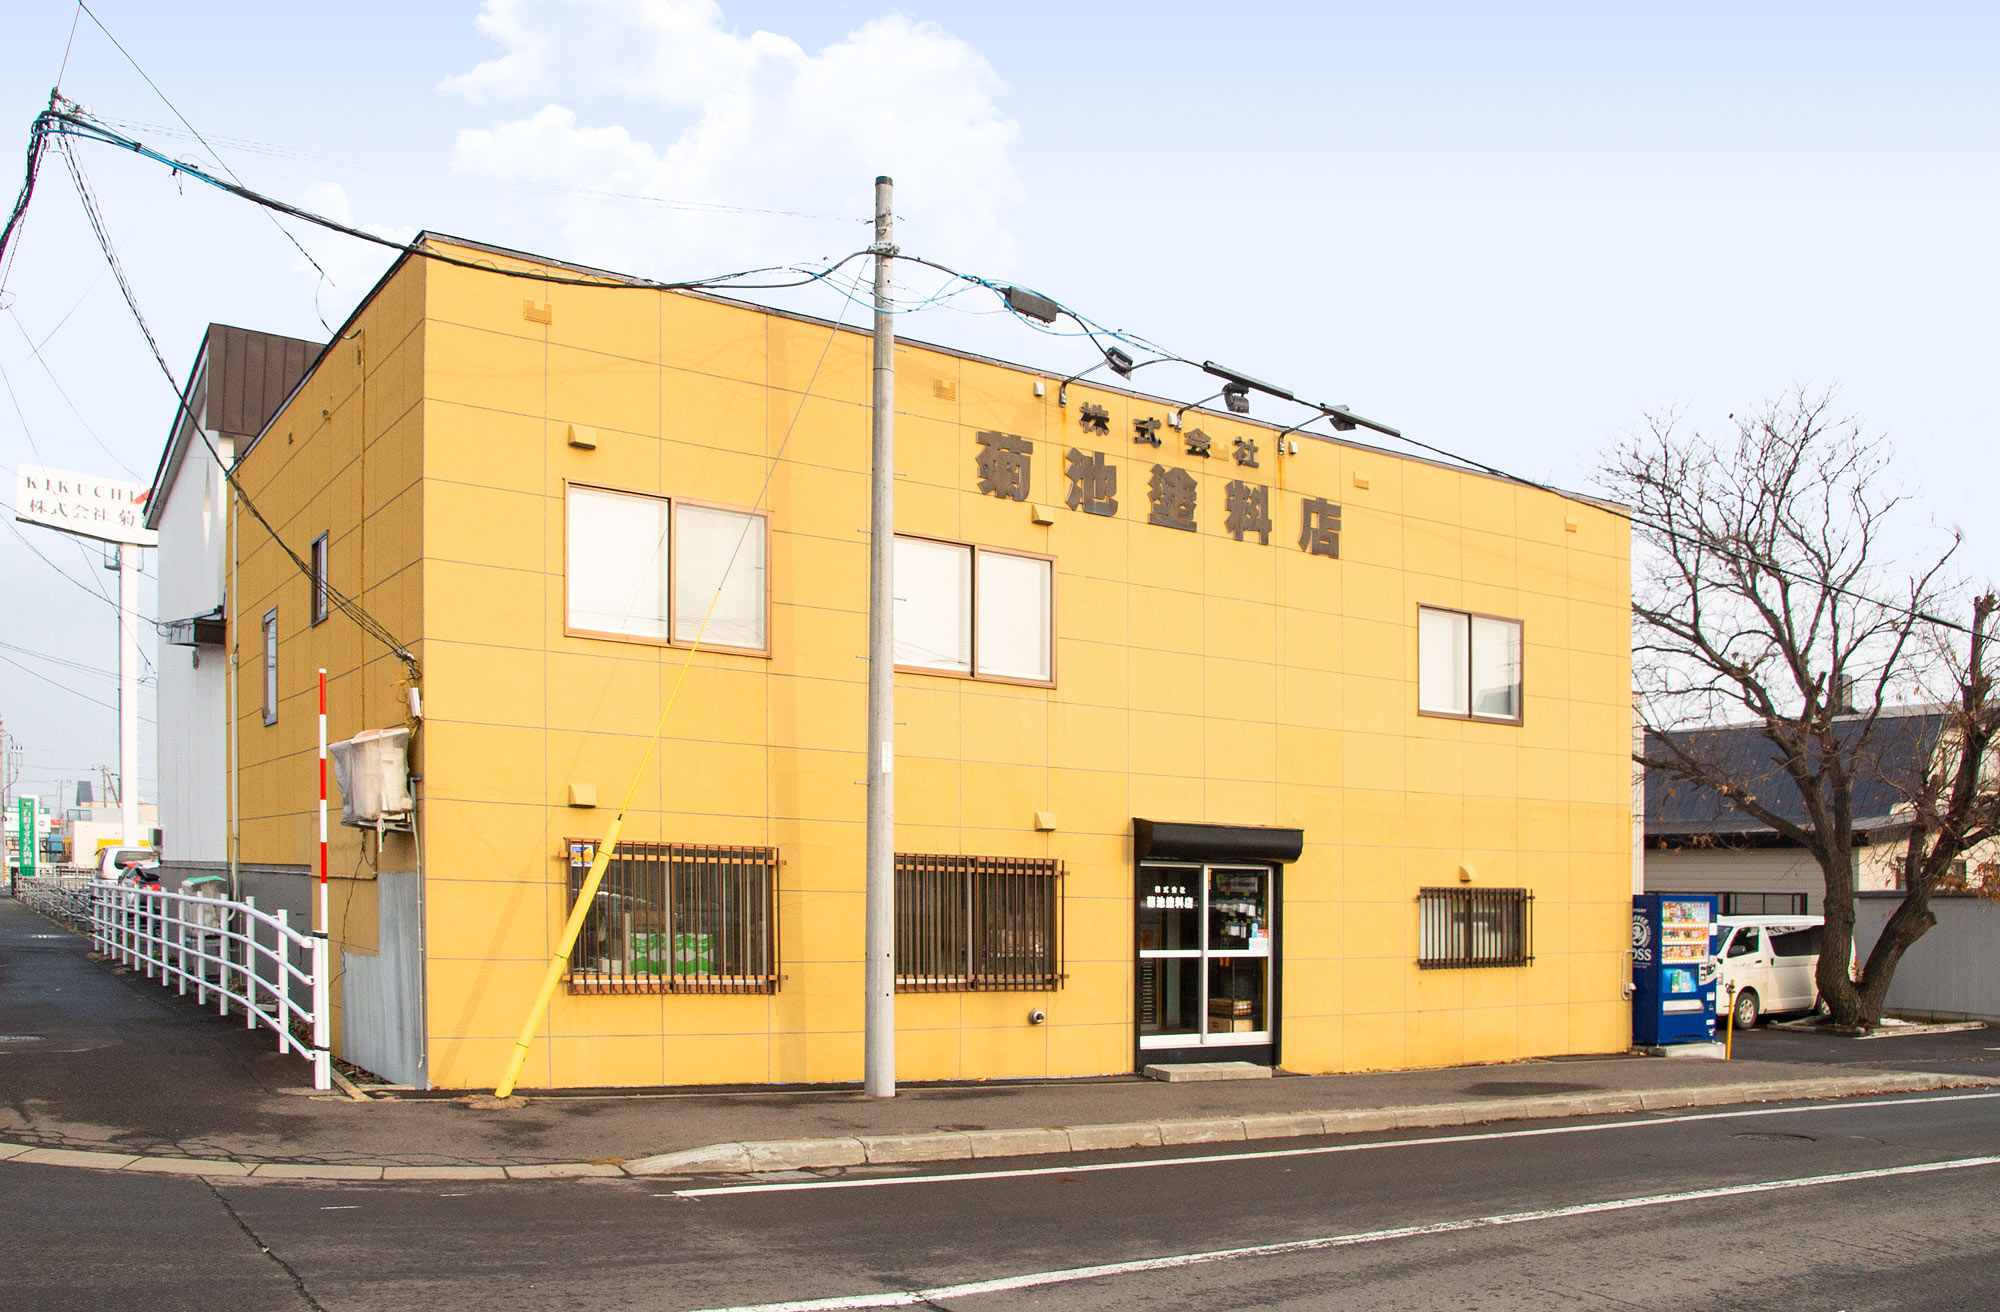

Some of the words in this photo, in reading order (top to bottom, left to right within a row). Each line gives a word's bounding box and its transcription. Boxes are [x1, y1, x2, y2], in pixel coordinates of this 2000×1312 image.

[1078, 401, 1260, 469] 株式会社
[27, 476, 136, 503] KIKUCHI
[976, 430, 1342, 560] 菊池塗料店
